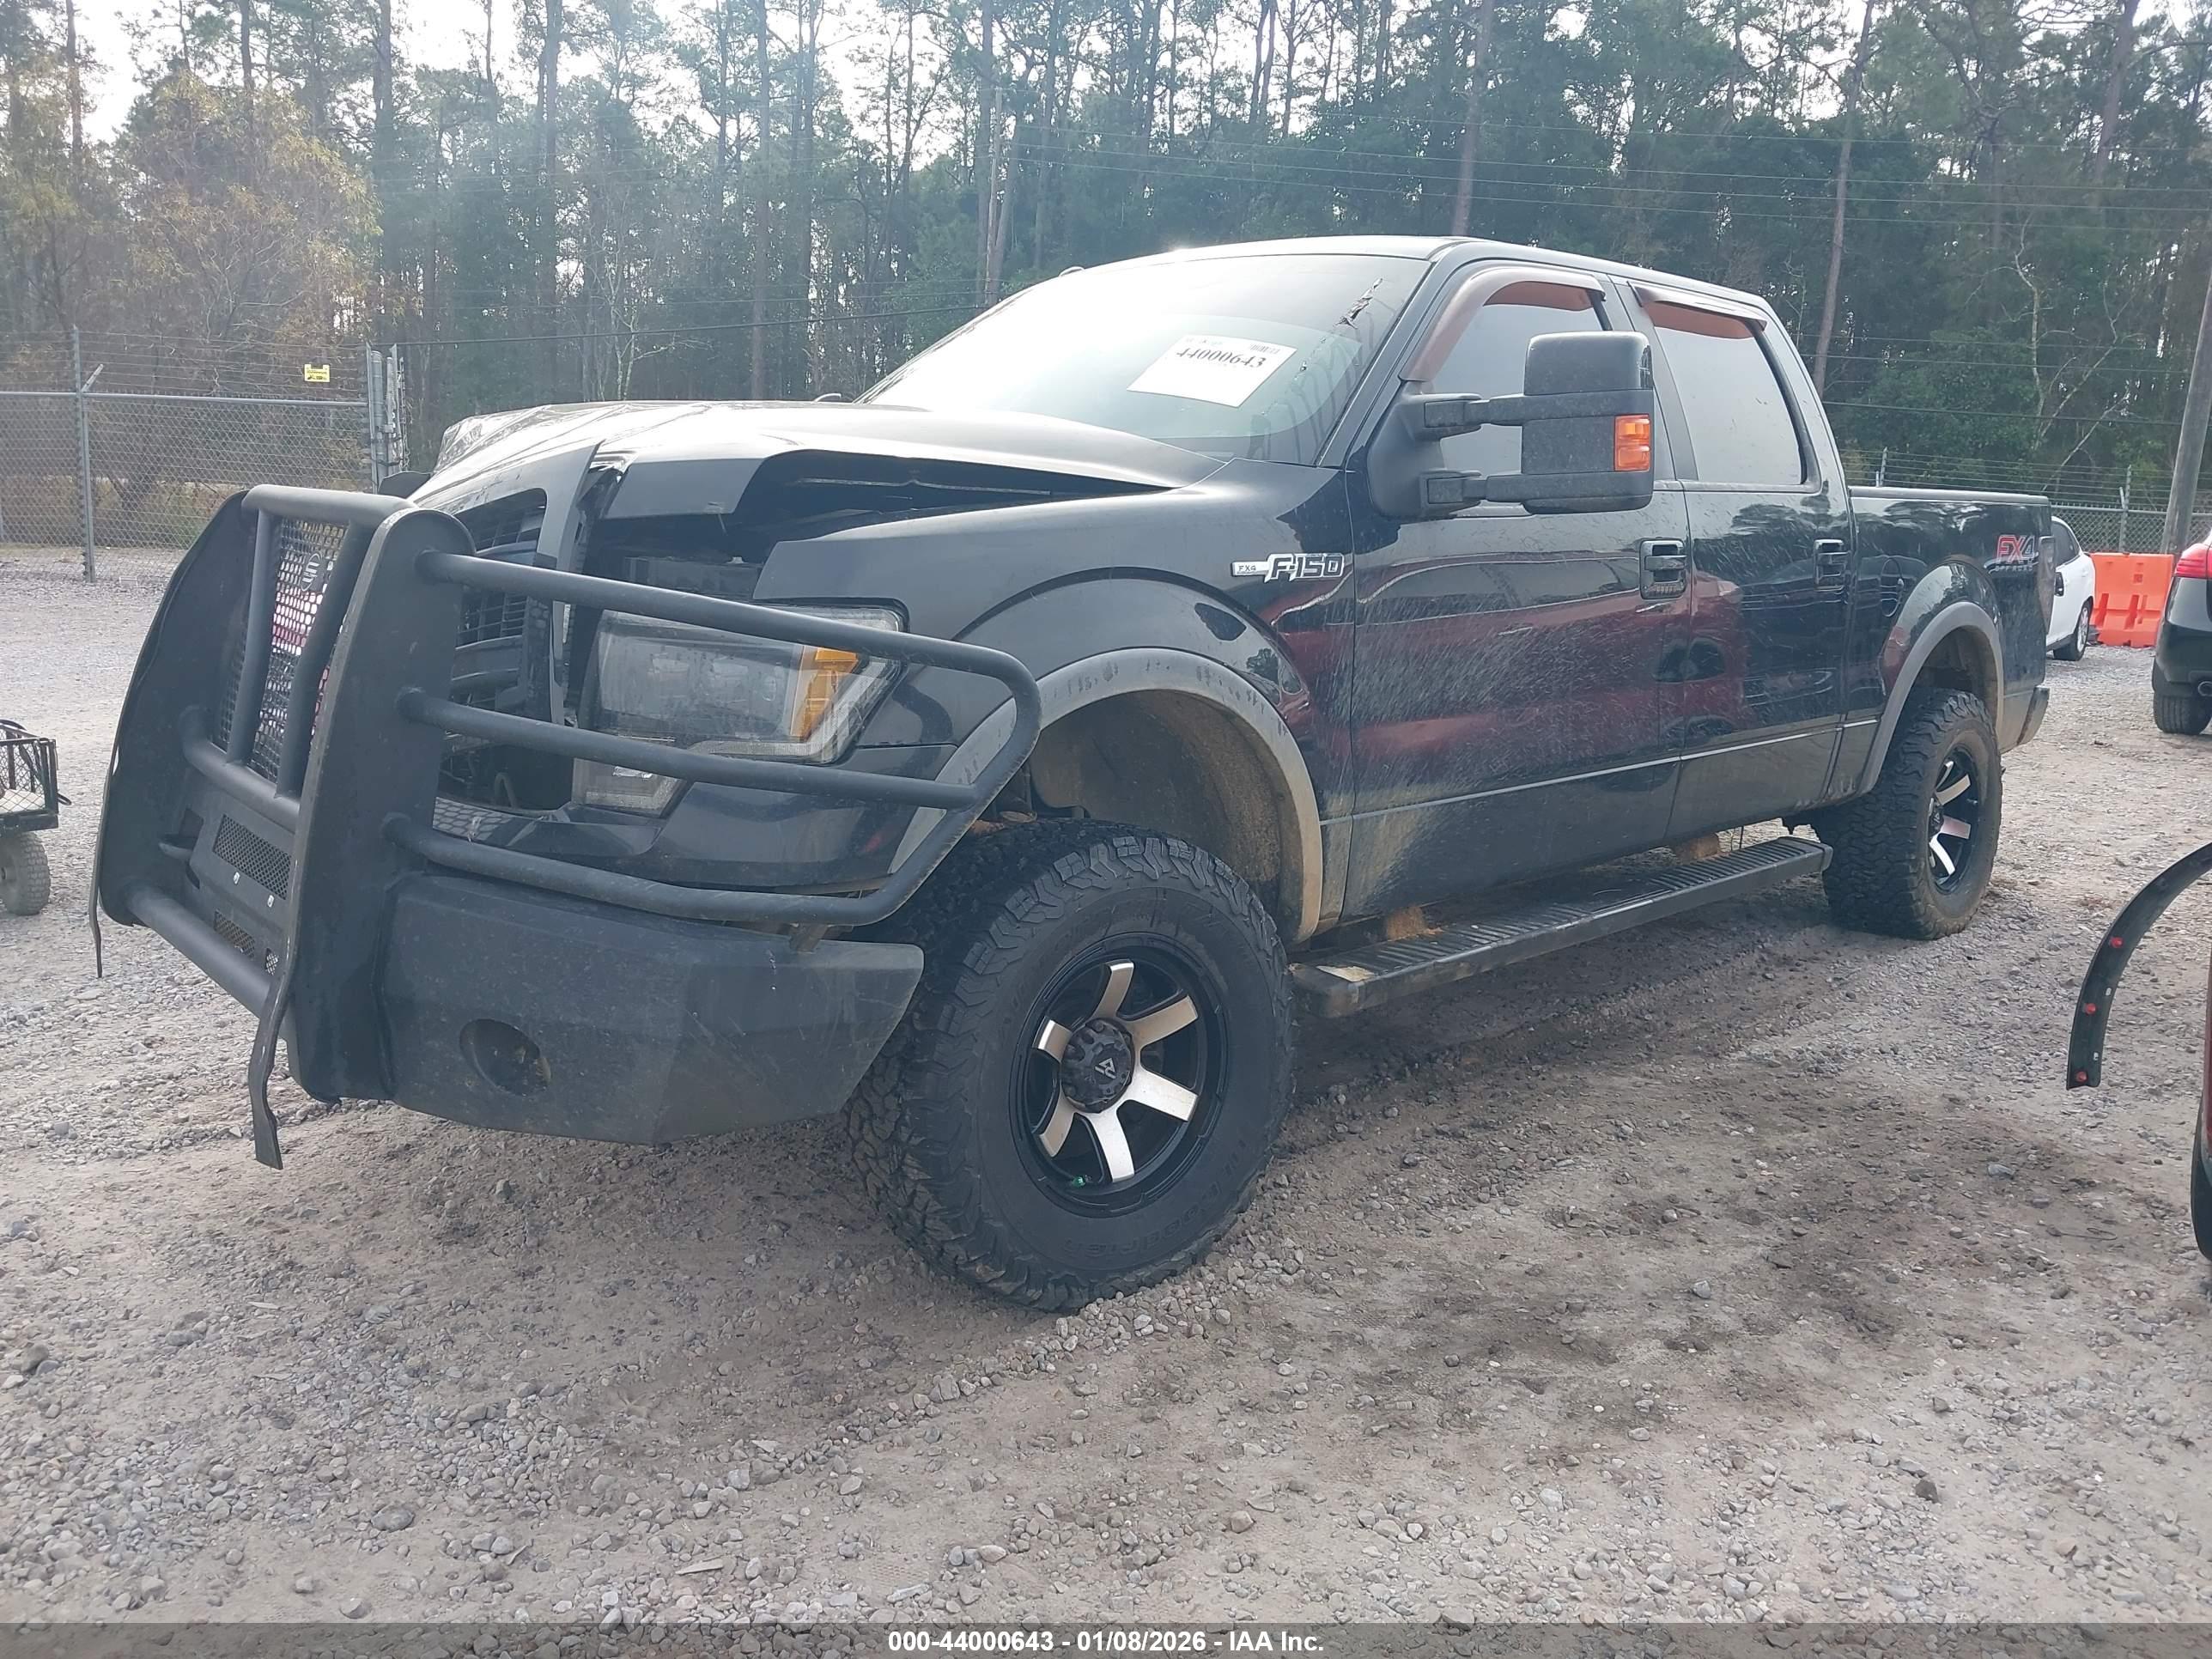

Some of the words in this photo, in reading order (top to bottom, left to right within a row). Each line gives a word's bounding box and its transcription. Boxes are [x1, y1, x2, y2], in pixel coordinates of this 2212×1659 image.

[1176, 348, 1267, 368] 44000643
[1996, 535, 2035, 562] FX4
[1265, 553, 1345, 583] F-150
